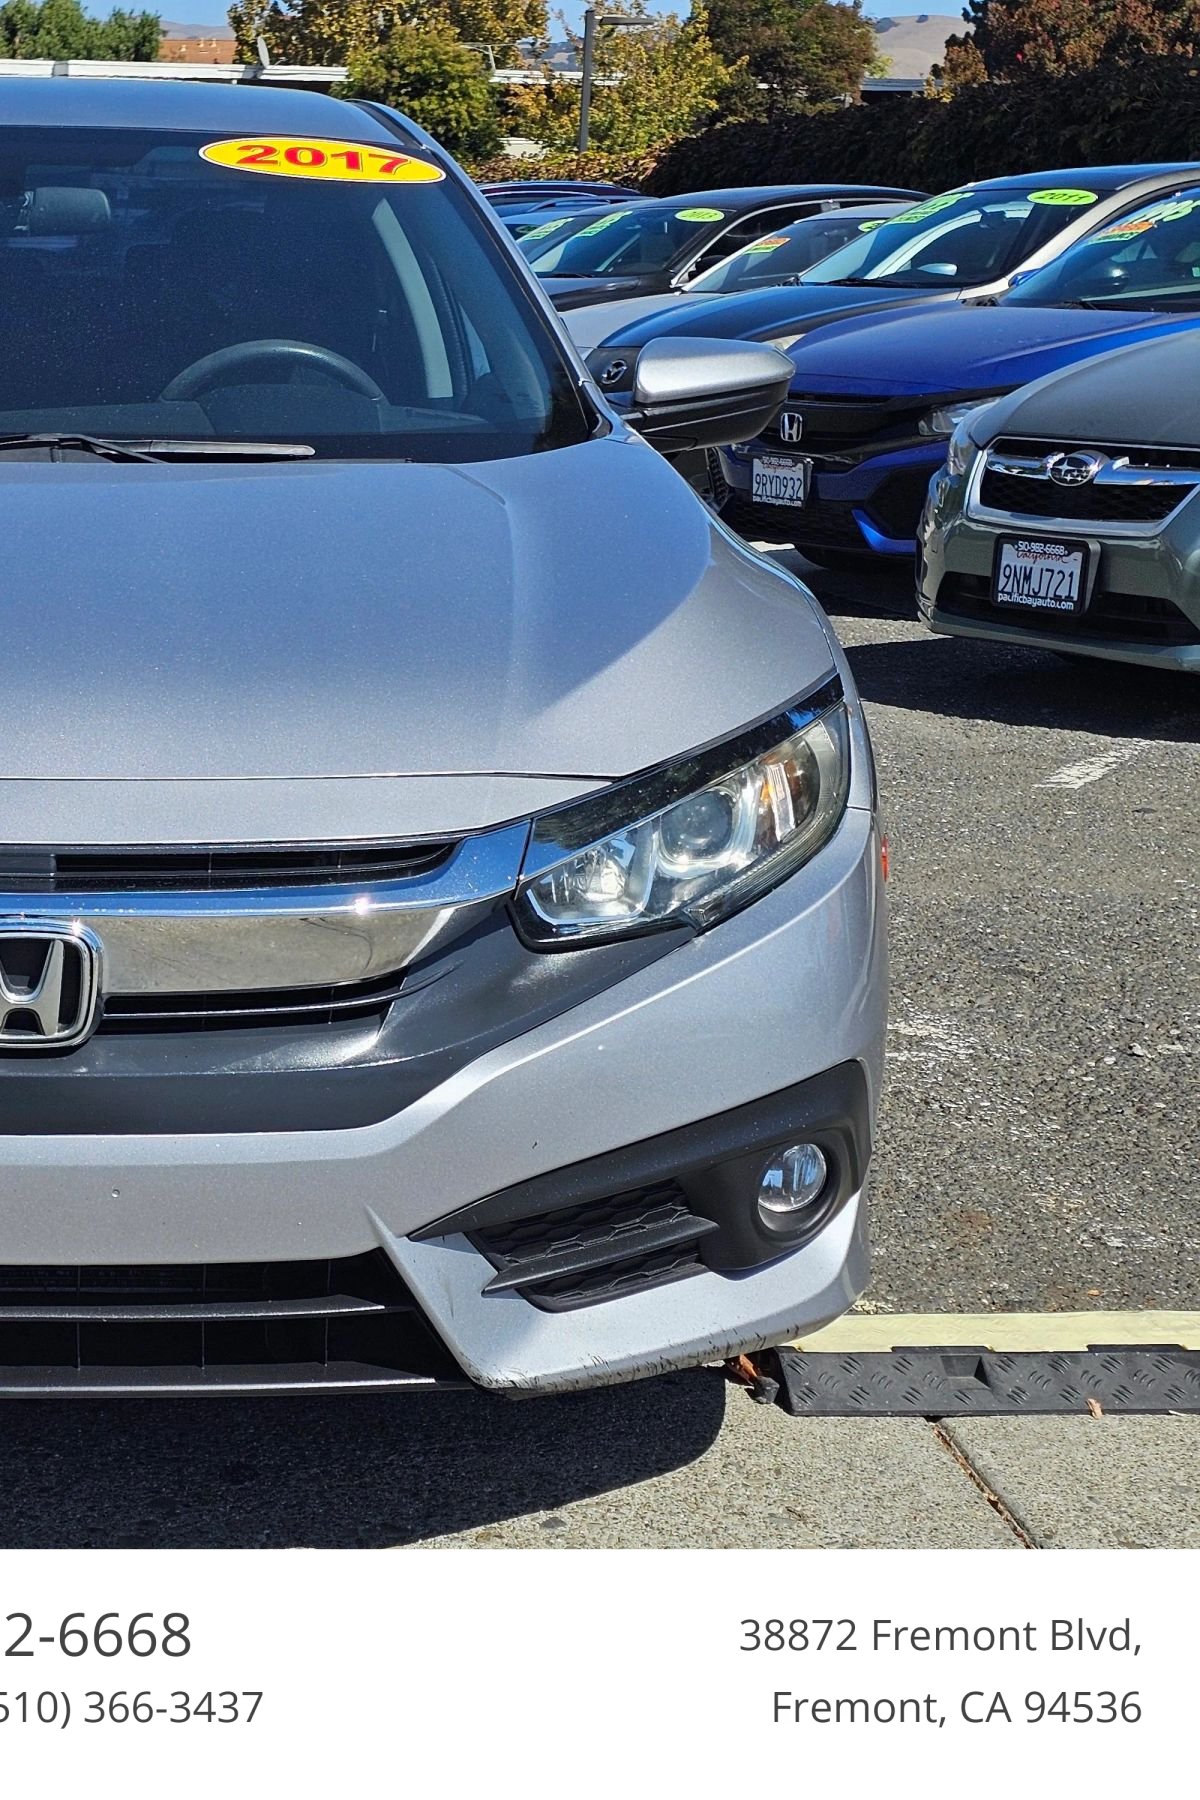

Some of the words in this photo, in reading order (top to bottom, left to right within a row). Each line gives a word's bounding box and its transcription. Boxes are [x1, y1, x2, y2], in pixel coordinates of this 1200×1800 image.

[236, 145, 411, 175] 2017
[1034, 192, 1090, 203] 2011
[754, 472, 803, 500] 9RYD932
[1000, 563, 1075, 600] 9NMJ721
[997, 593, 1075, 611] pacificbayauto.com
